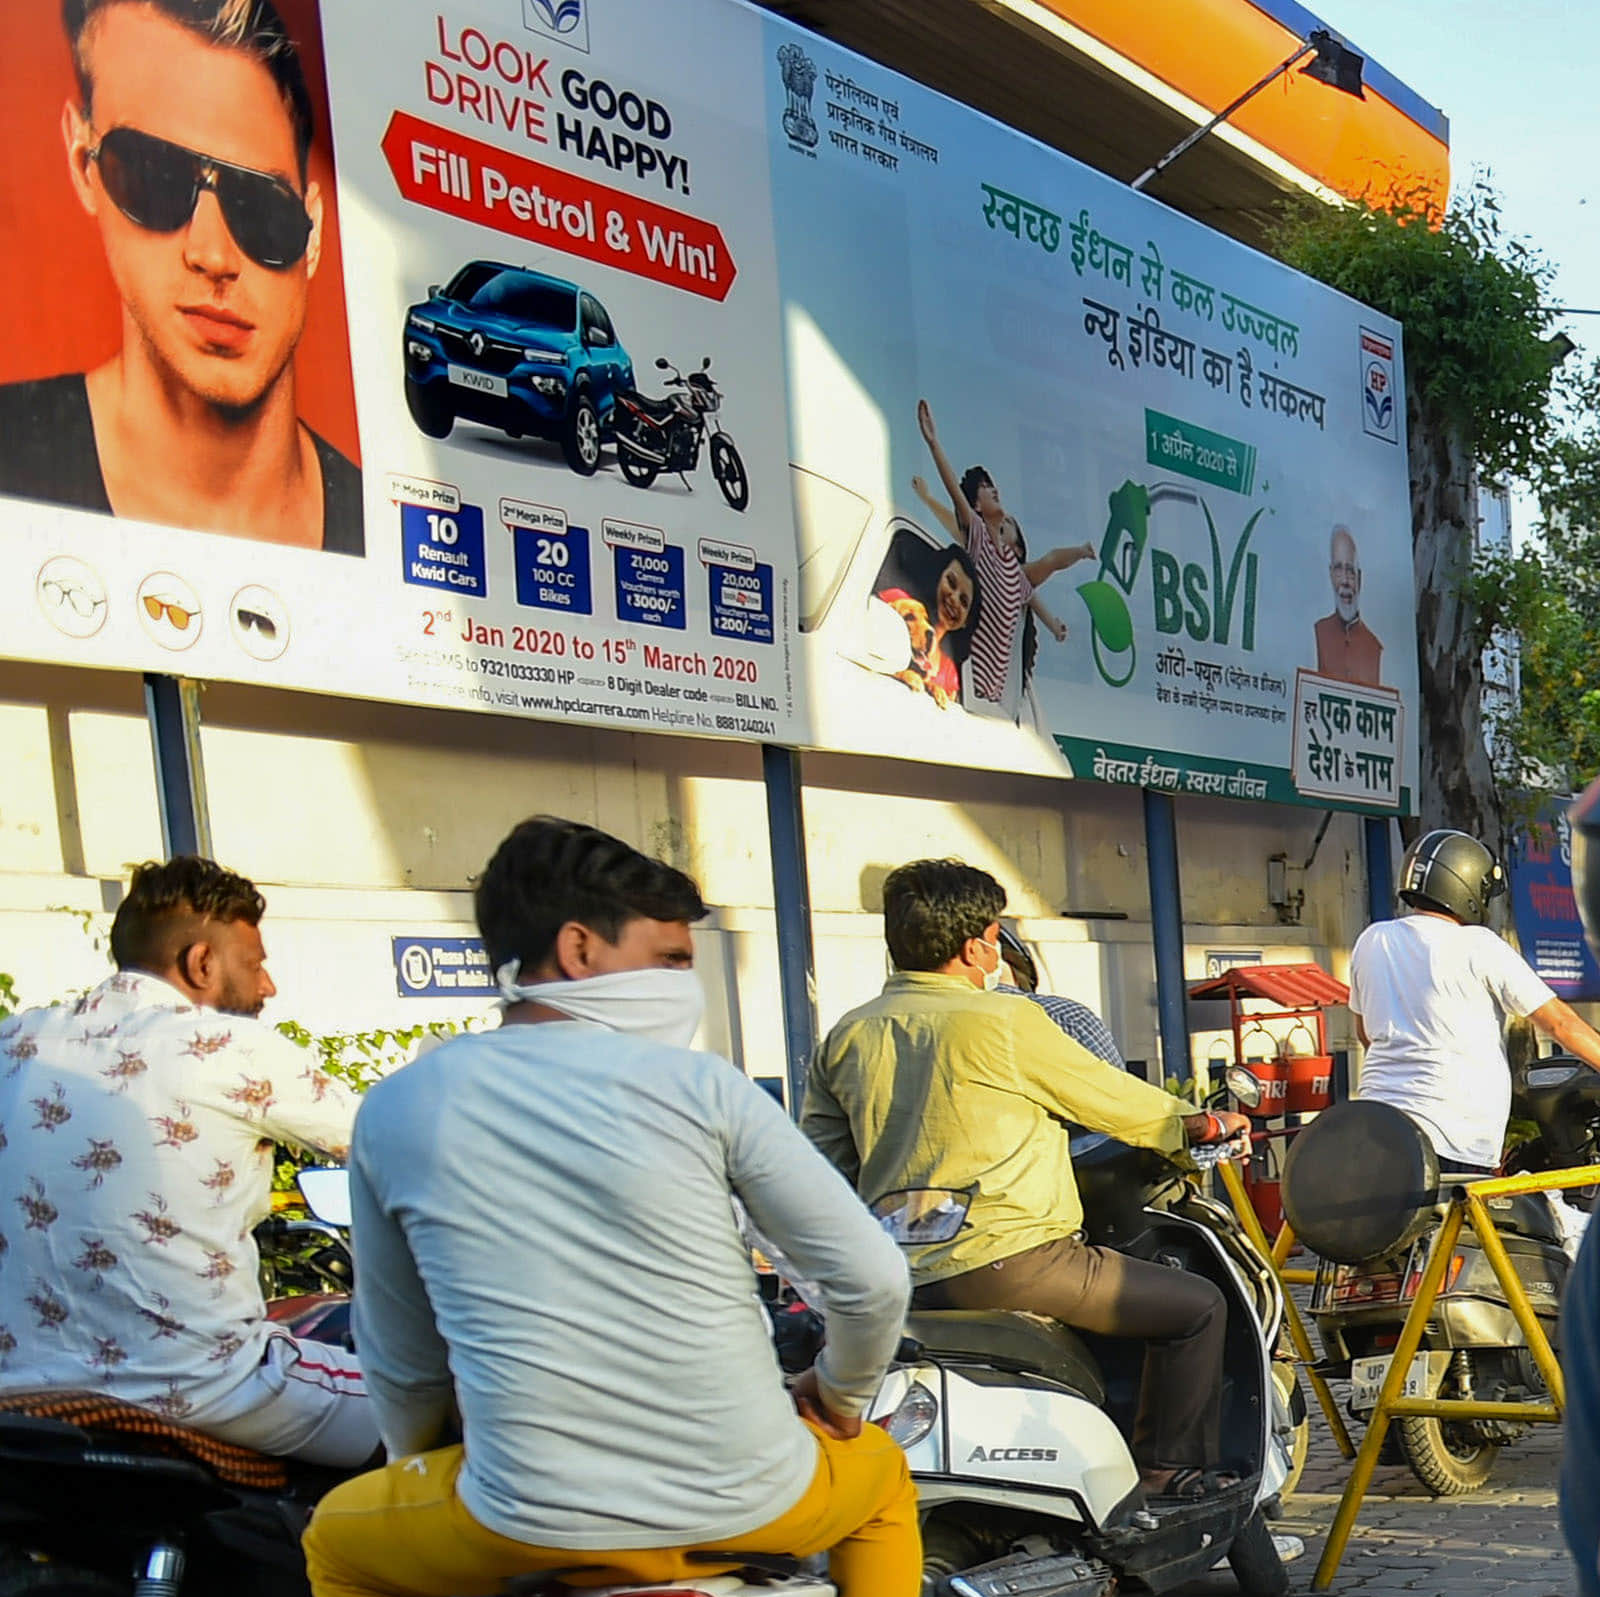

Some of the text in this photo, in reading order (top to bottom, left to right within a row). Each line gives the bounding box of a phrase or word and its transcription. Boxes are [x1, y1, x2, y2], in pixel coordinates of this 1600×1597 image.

[437, 15, 671, 140] LOOK GOOD
[824, 69, 878, 111] पेट्रोलियम
[425, 60, 690, 195] DRIVE HAPPY!
[829, 130, 858, 155] भारत
[862, 143, 898, 172] सरकार
[410, 140, 717, 282] Fill Petrol & Win!
[981, 182, 1061, 253] स्वच्छ
[1140, 241, 1164, 301] से
[1171, 269, 1214, 322] कल
[1221, 292, 1299, 358] उज्ज्वल
[1082, 297, 1326, 431] न्यू इंडिया का है संकल्प
[1151, 431, 1157, 451] 1
[1161, 430, 1194, 462] अप्रैल
[1196, 447, 1225, 472] 2020
[432, 490, 455, 505] Prize
[426, 514, 458, 545] 10
[516, 509, 541, 524] Mega
[542, 514, 564, 528] Prize
[605, 525, 661, 547] Weekly Prizes
[418, 543, 469, 567] Renault
[536, 538, 568, 567] 20
[631, 554, 669, 573] 21,000
[701, 545, 753, 564] Weekly Prizes
[411, 562, 478, 588] Kwid Cars
[532, 567, 575, 588] 100 CC
[722, 572, 760, 590] 20,000
[539, 588, 571, 605] Bikes
[621, 581, 680, 599] Vouchers worth
[643, 612, 662, 623] each
[422, 610, 757, 684] 2nd Jan 2020 to 15th March 2020
[557, 671, 575, 686] HP
[617, 678, 642, 696] Digit
[645, 680, 680, 699] Dealer
[683, 687, 708, 702] code
[736, 693, 759, 709] BILL
[1304, 692, 1396, 743] हर एक काम
[1093, 748, 1137, 784] बेहतर
[1185, 769, 1227, 797] स्वस्थ
[1227, 768, 1267, 800] जीवन
[1308, 728, 1341, 782] देश
[1357, 749, 1394, 792] नाम
[1368, 1364, 1385, 1381] UP
[967, 1445, 1058, 1462] ACCESS
